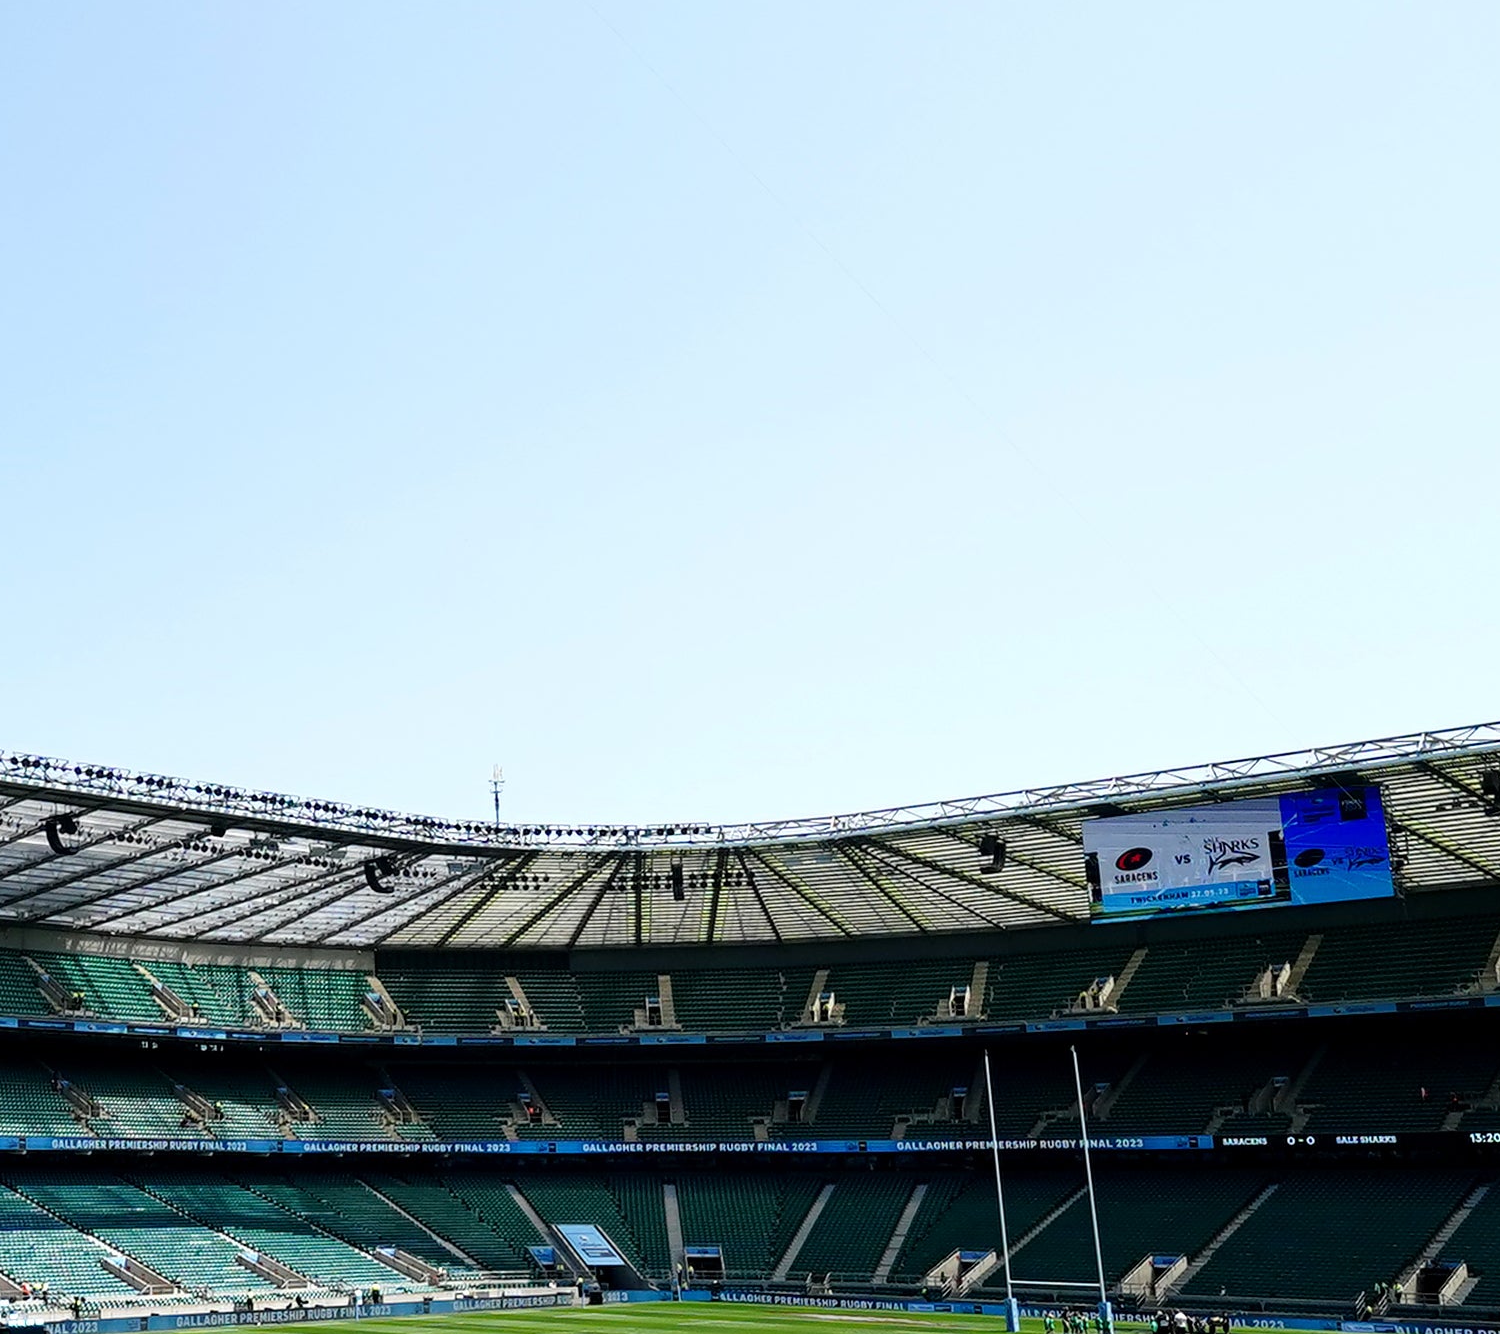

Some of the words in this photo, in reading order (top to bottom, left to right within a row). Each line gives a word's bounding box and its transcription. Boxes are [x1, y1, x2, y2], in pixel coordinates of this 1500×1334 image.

[1114, 871, 1159, 885] SARACENS
[52, 1139, 107, 1151] GALLAGHER
[109, 1140, 168, 1151] PREMIERSHIP
[171, 1140, 199, 1152] RUGBY
[201, 1141, 225, 1152] FINAL
[227, 1142, 247, 1153] 2023
[304, 1142, 359, 1153] GALLAGHER
[361, 1142, 420, 1153] PREMIERSHIP
[422, 1143, 453, 1153] RUGBY
[455, 1143, 484, 1153] FINAL
[487, 1143, 511, 1153] 2023
[583, 1143, 644, 1153] GALLAGHER
[646, 1143, 717, 1153] PREMIERSHIP
[720, 1143, 755, 1153] RUGBY
[759, 1143, 789, 1153] FINAL
[792, 1142, 818, 1152] 2023
[897, 1141, 964, 1151] GALLAGHER
[966, 1140, 1037, 1150] PREMERSHIP
[1040, 1140, 1077, 1149] RUGBY
[1080, 1139, 1113, 1149] FNAL
[1116, 1138, 1144, 1148] 2023
[1287, 1136, 1296, 1146] 0
[1306, 1136, 1316, 1146] 0
[775, 1295, 838, 1309] PREMIERSHIP
[840, 1298, 873, 1310] RUGBY
[877, 1300, 905, 1312] FINAL
[176, 1311, 238, 1328] GALLAGHER
[240, 1308, 305, 1325] PREMIERSHIP
[308, 1306, 338, 1320] RUGBY
[369, 1304, 391, 1317] 2023
[71, 1320, 98, 1334] 2023
